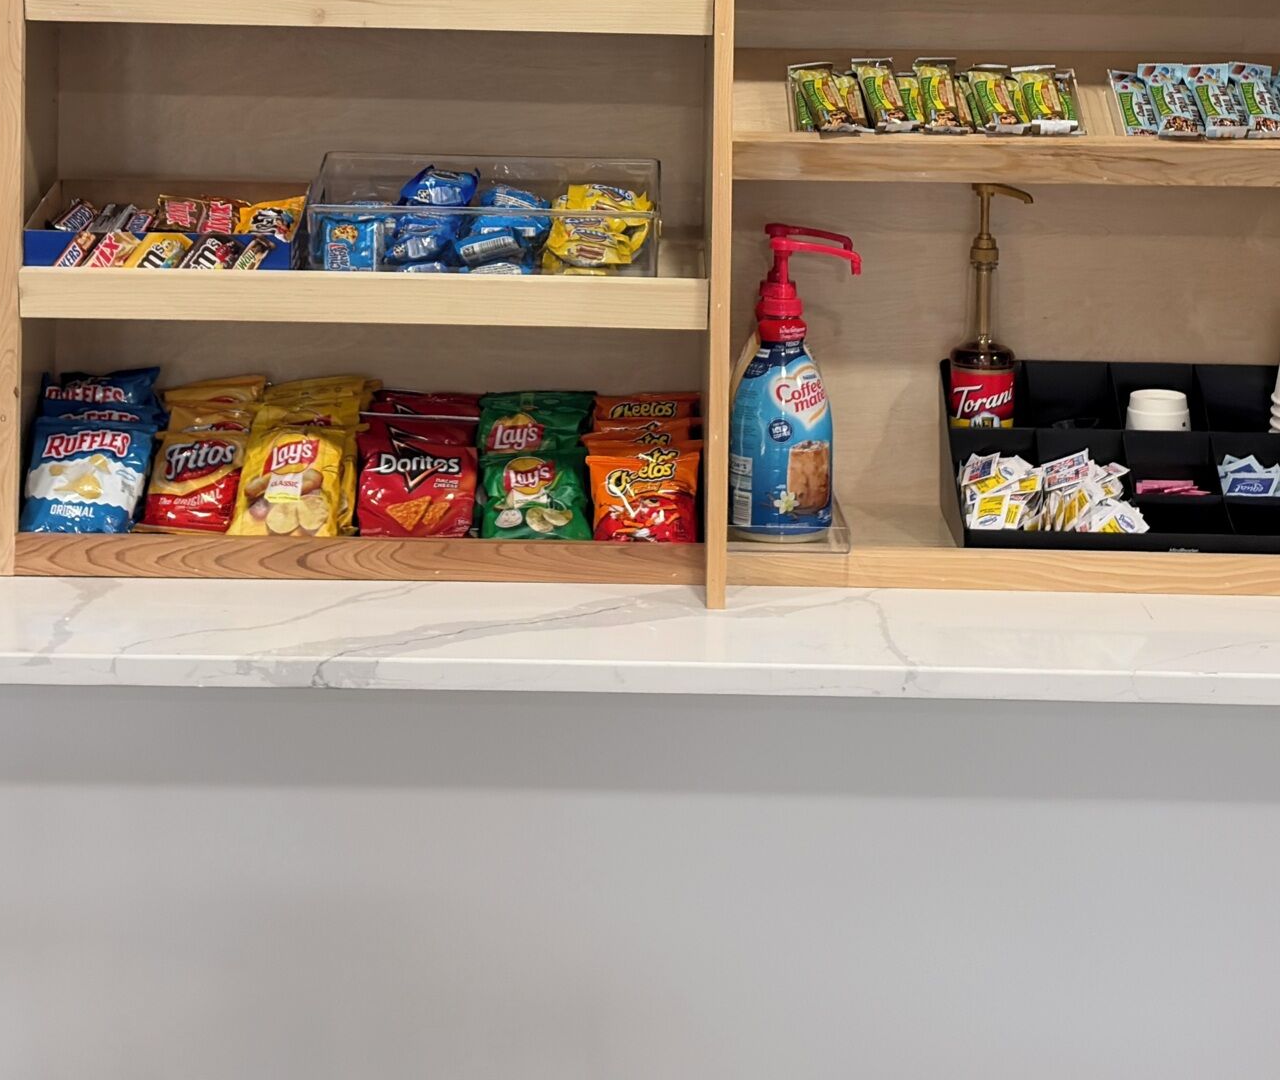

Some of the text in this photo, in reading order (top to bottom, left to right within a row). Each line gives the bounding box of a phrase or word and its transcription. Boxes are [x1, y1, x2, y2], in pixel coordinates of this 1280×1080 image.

[776, 379, 822, 403] Coffee
[953, 382, 1013, 419] Torani
[42, 430, 131, 458] RUFFLES
[494, 423, 538, 450] Lay's
[165, 440, 236, 480] Fritos
[270, 440, 313, 471] Lay's
[380, 454, 460, 474] Doritos
[510, 465, 552, 488] Lay's
[608, 462, 674, 494] Cheetos
